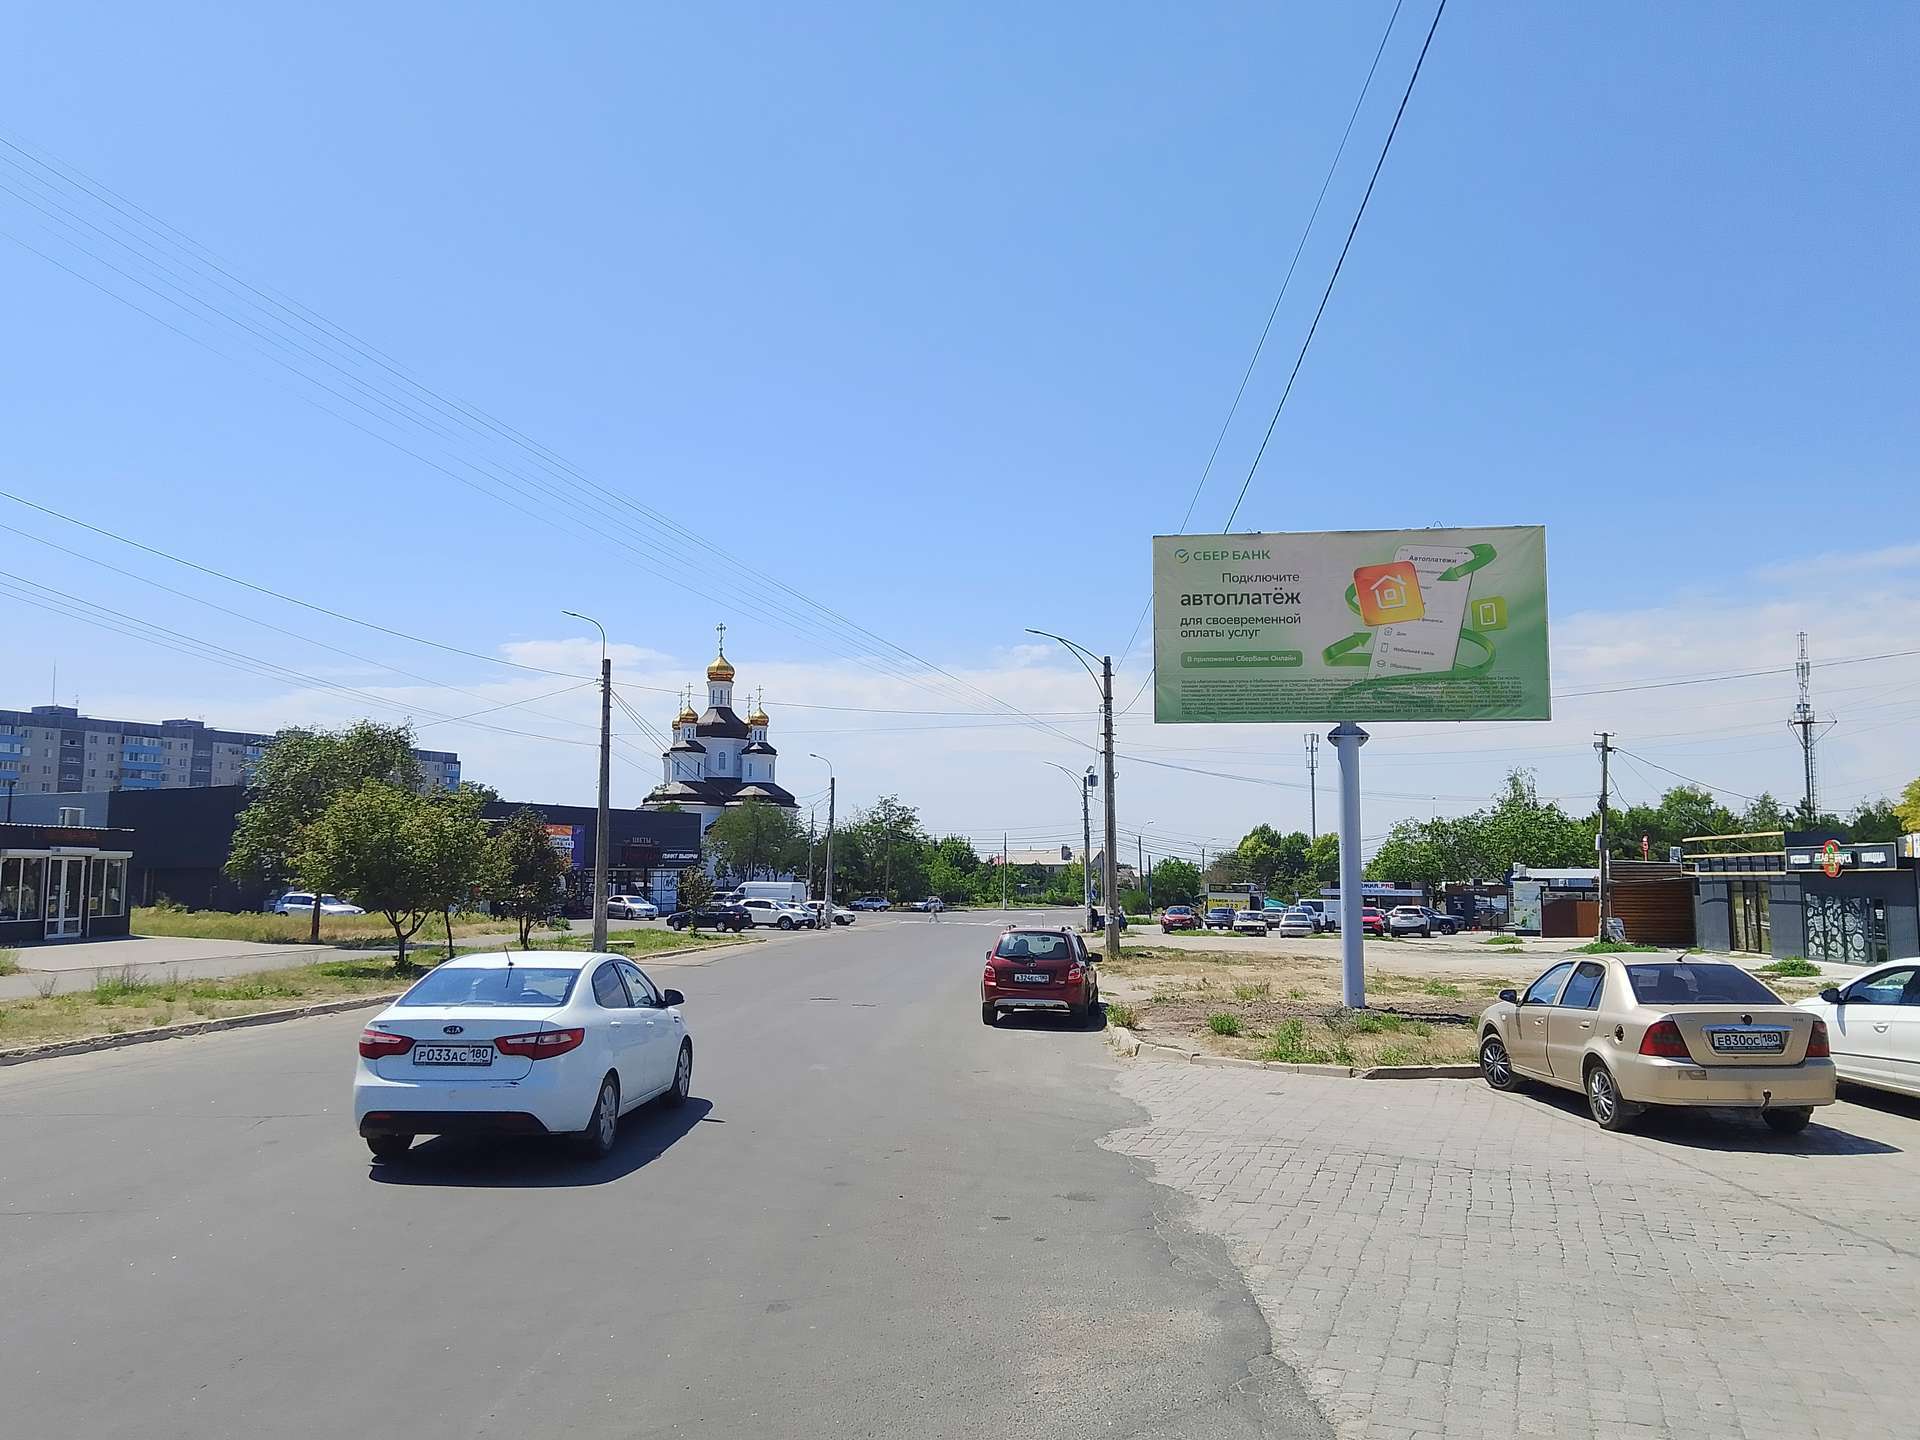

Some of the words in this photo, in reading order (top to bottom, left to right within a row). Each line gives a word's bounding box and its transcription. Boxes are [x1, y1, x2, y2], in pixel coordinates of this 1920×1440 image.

[1193, 551, 1229, 561] СБЕР
[1232, 549, 1271, 560] БАНК
[1222, 572, 1300, 584] Подключите
[1180, 587, 1301, 606] автоплатёж
[1180, 616, 1202, 627] для
[1205, 613, 1301, 626] своевременной
[1180, 630, 1225, 639] оплаты
[1228, 628, 1261, 640] услуг
